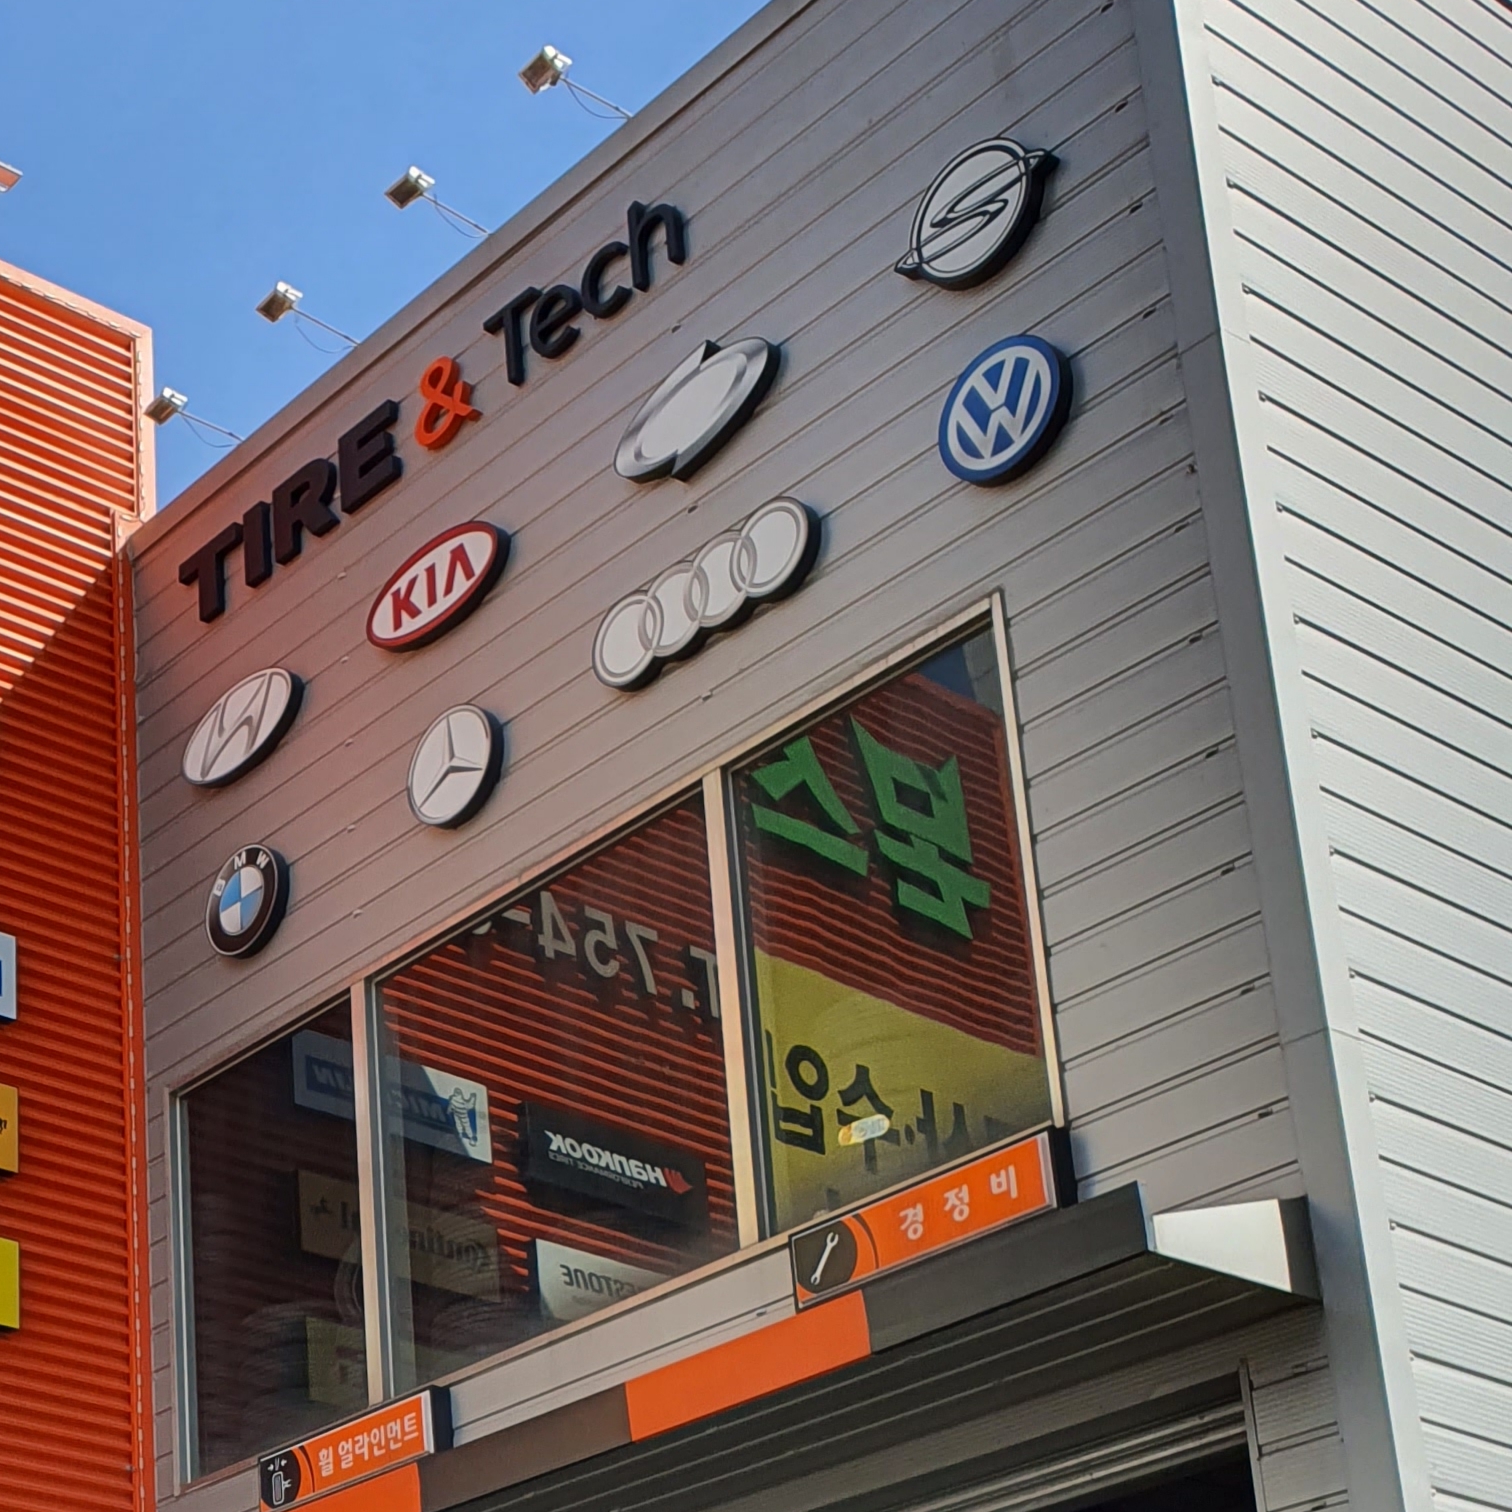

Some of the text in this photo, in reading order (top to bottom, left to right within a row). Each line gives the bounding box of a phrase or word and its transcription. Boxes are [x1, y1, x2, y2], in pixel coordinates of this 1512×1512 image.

[178, 199, 688, 624] TIRE & Tech
[389, 541, 477, 634] KIA
